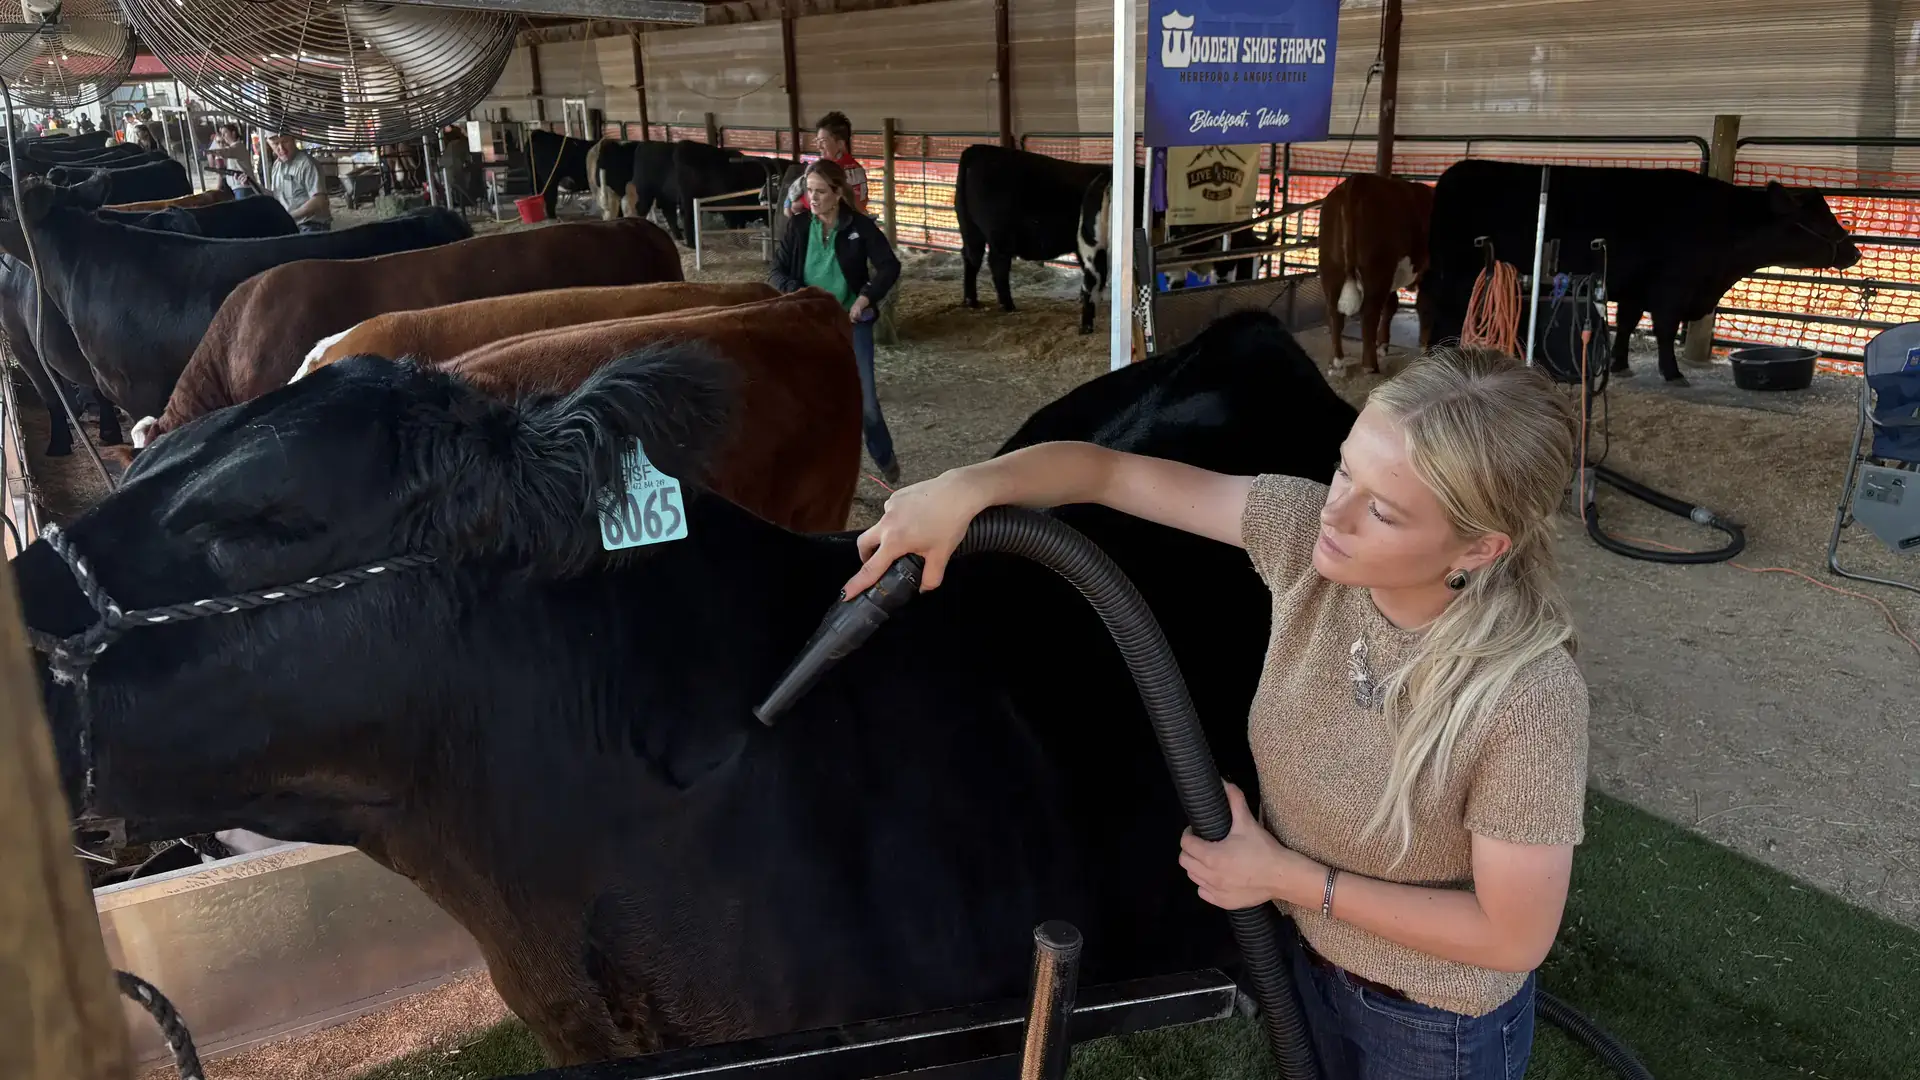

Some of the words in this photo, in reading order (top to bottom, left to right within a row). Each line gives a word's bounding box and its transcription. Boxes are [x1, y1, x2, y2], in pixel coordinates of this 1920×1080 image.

[1161, 30, 1240, 68] WOODEN
[1241, 37, 1277, 64] SHOE
[1279, 38, 1327, 65] FARMS
[1179, 71, 1230, 83] HEREFORD
[1233, 71, 1239, 83] &
[1243, 71, 1273, 83] ANGUS
[1276, 71, 1308, 83] CATTLE
[1256, 107, 1291, 129] Idaho
[1190, 169, 1212, 184] LIVE
